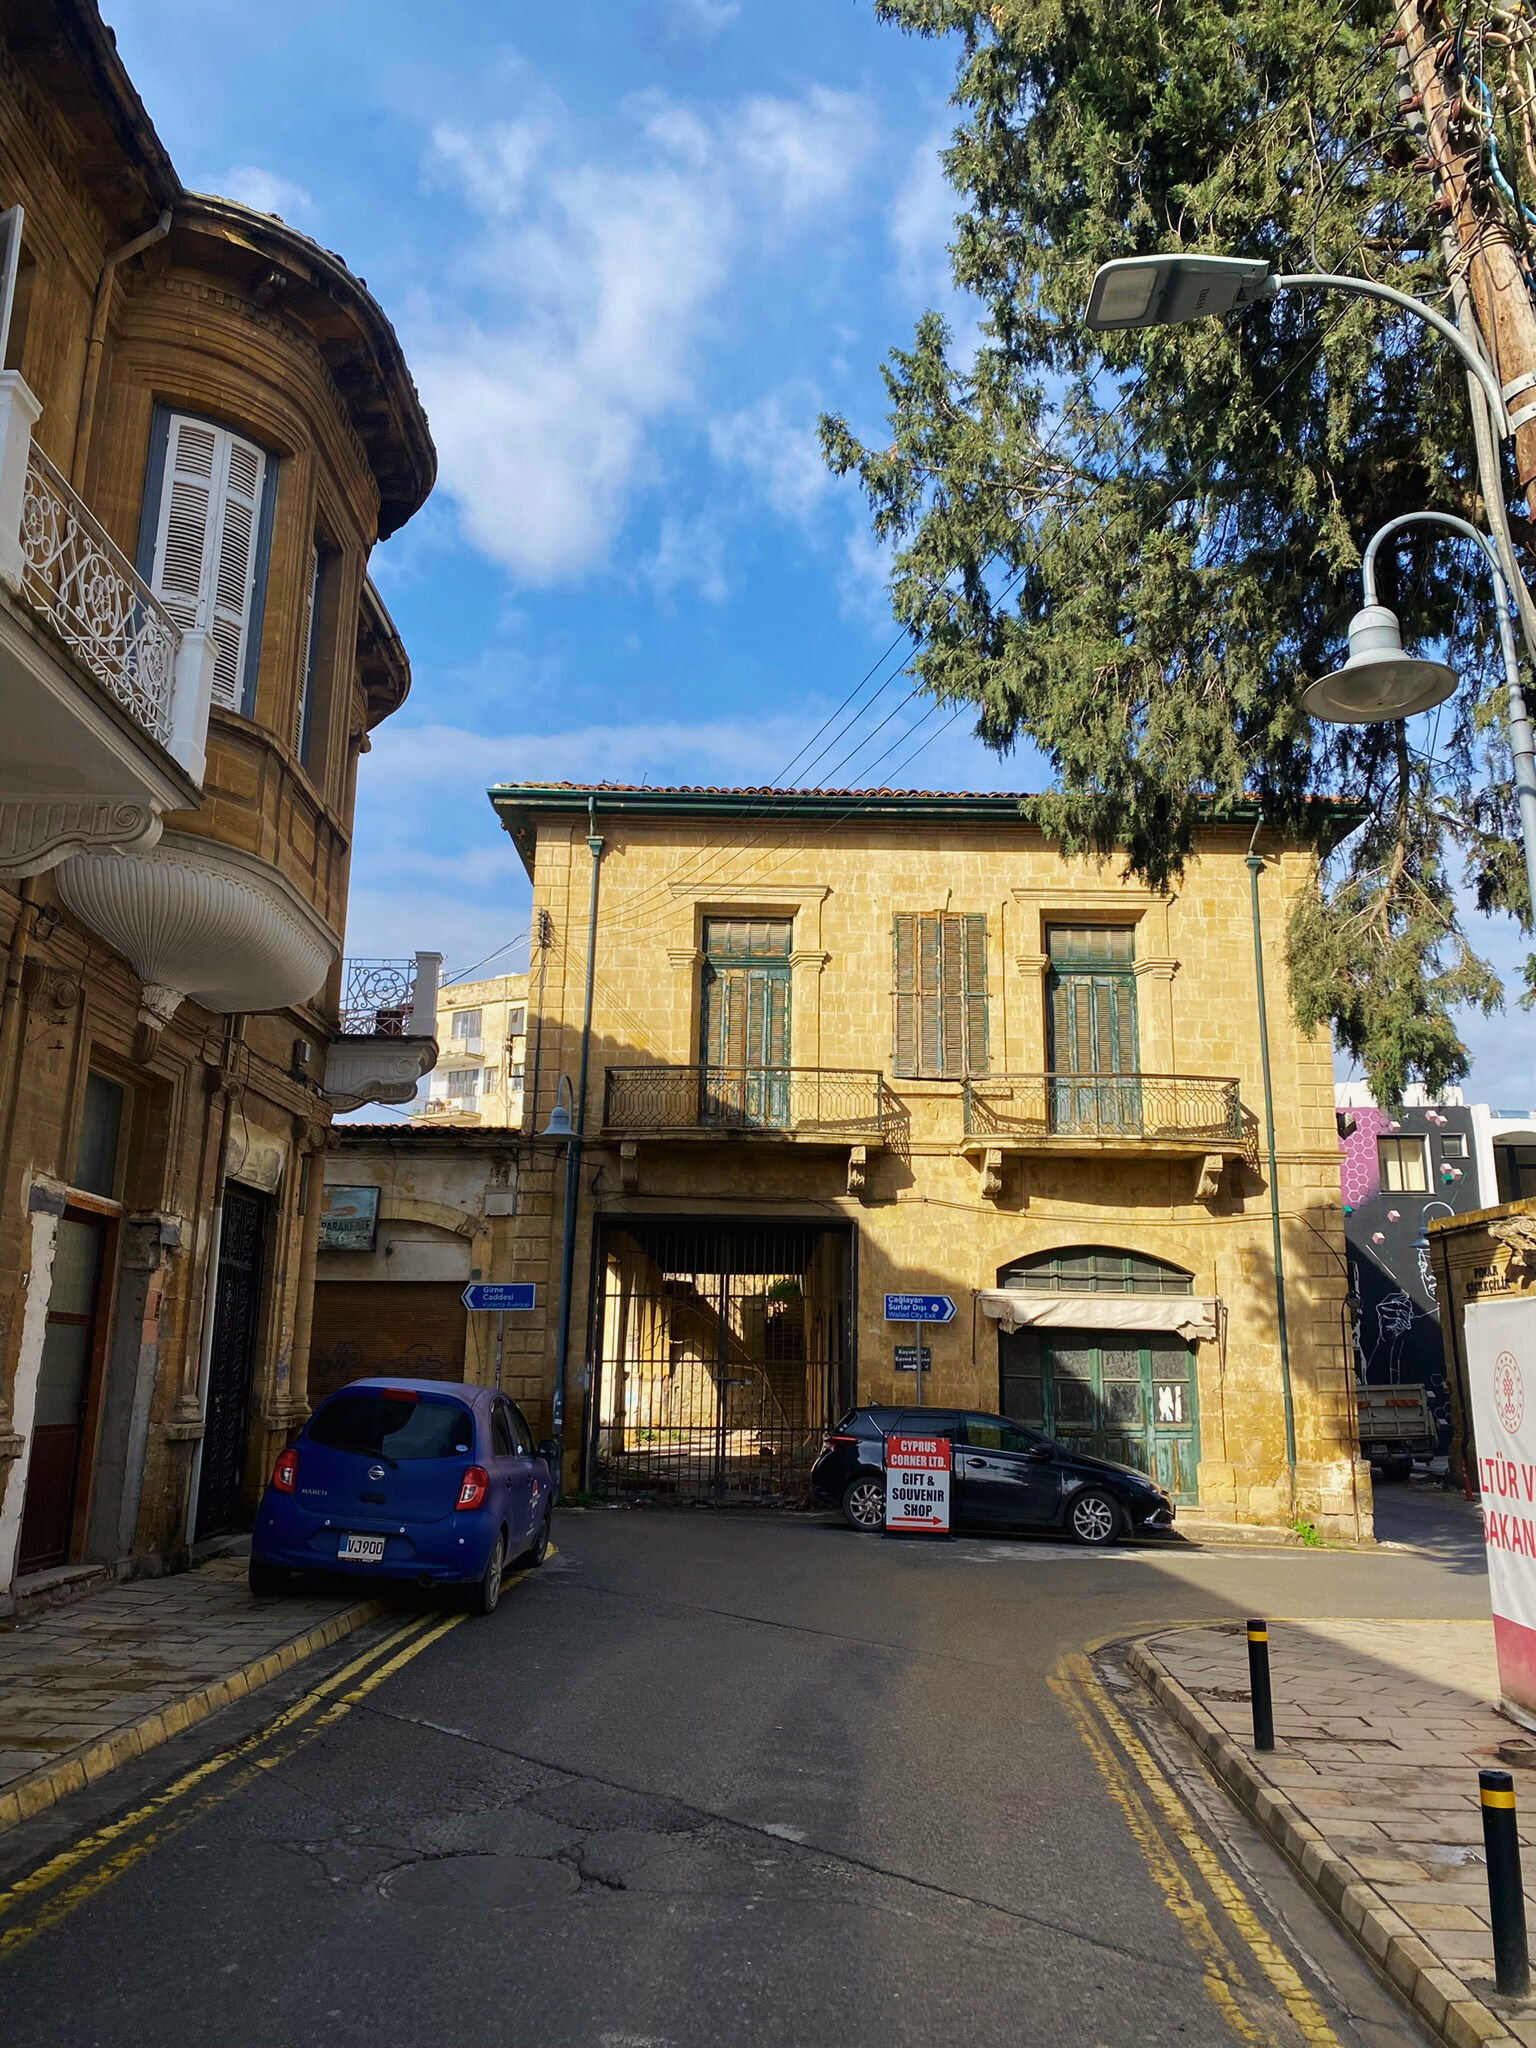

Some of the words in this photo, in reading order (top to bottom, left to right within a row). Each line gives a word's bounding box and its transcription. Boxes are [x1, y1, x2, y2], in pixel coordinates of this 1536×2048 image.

[23, 1273, 29, 1286] 7
[482, 1293, 514, 1301] Caddesi
[888, 1295, 923, 1305] Çağlayan
[888, 1303, 911, 1311] Surlar
[912, 1304, 927, 1312] Dışı
[900, 1440, 937, 1453] CYPRUS
[891, 1454, 927, 1467] CORNER
[928, 1456, 947, 1468] LTD.
[902, 1472, 925, 1486] GIFT
[926, 1475, 935, 1487] &
[301, 1488, 328, 1496] MARCH
[892, 1487, 944, 1502] SOUVENIR
[904, 1503, 933, 1518] SHOP
[347, 1539, 383, 1554] VJ900
